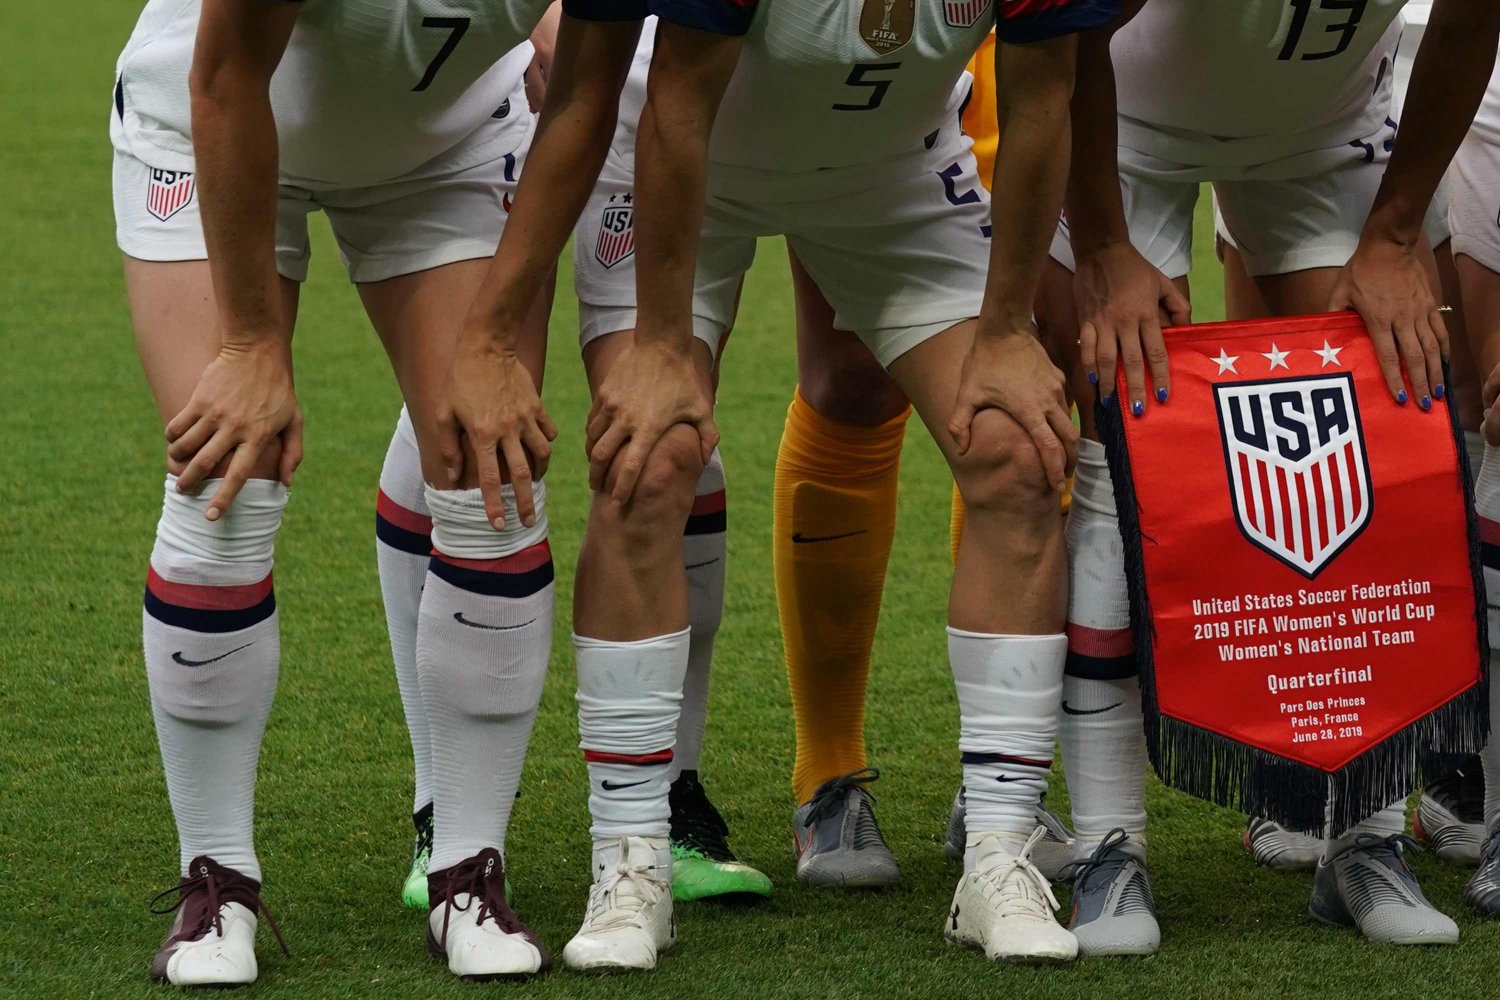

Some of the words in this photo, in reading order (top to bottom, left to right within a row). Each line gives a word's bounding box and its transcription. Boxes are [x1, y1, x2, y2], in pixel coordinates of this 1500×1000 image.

[872, 29, 897, 41] FIFA
[411, 16, 472, 92] 7
[832, 62, 902, 111] 5
[1228, 387, 1349, 463] USA
[1192, 595, 1241, 616] United
[1244, 593, 1294, 611] States
[1298, 588, 1347, 606] Soccer
[1351, 578, 1431, 601] Federation
[1194, 621, 1230, 640] 2019
[1234, 617, 1269, 637] FIFA
[1272, 610, 1347, 633] Women's
[1351, 604, 1401, 625] World
[1405, 602, 1435, 621] Cup
[1218, 639, 1293, 662] Women's
[1298, 631, 1368, 654] National
[1372, 629, 1415, 647] Team
[1267, 665, 1373, 694] Quarterfinal
[1280, 702, 1304, 714] Parc
[1306, 699, 1325, 711] Des
[1327, 696, 1366, 709] Princes
[1291, 715, 1322, 728] Paris,
[1324, 712, 1359, 725] France
[1292, 732, 1318, 743] June
[1320, 729, 1337, 740] 28,
[1339, 726, 1363, 738] 2019
